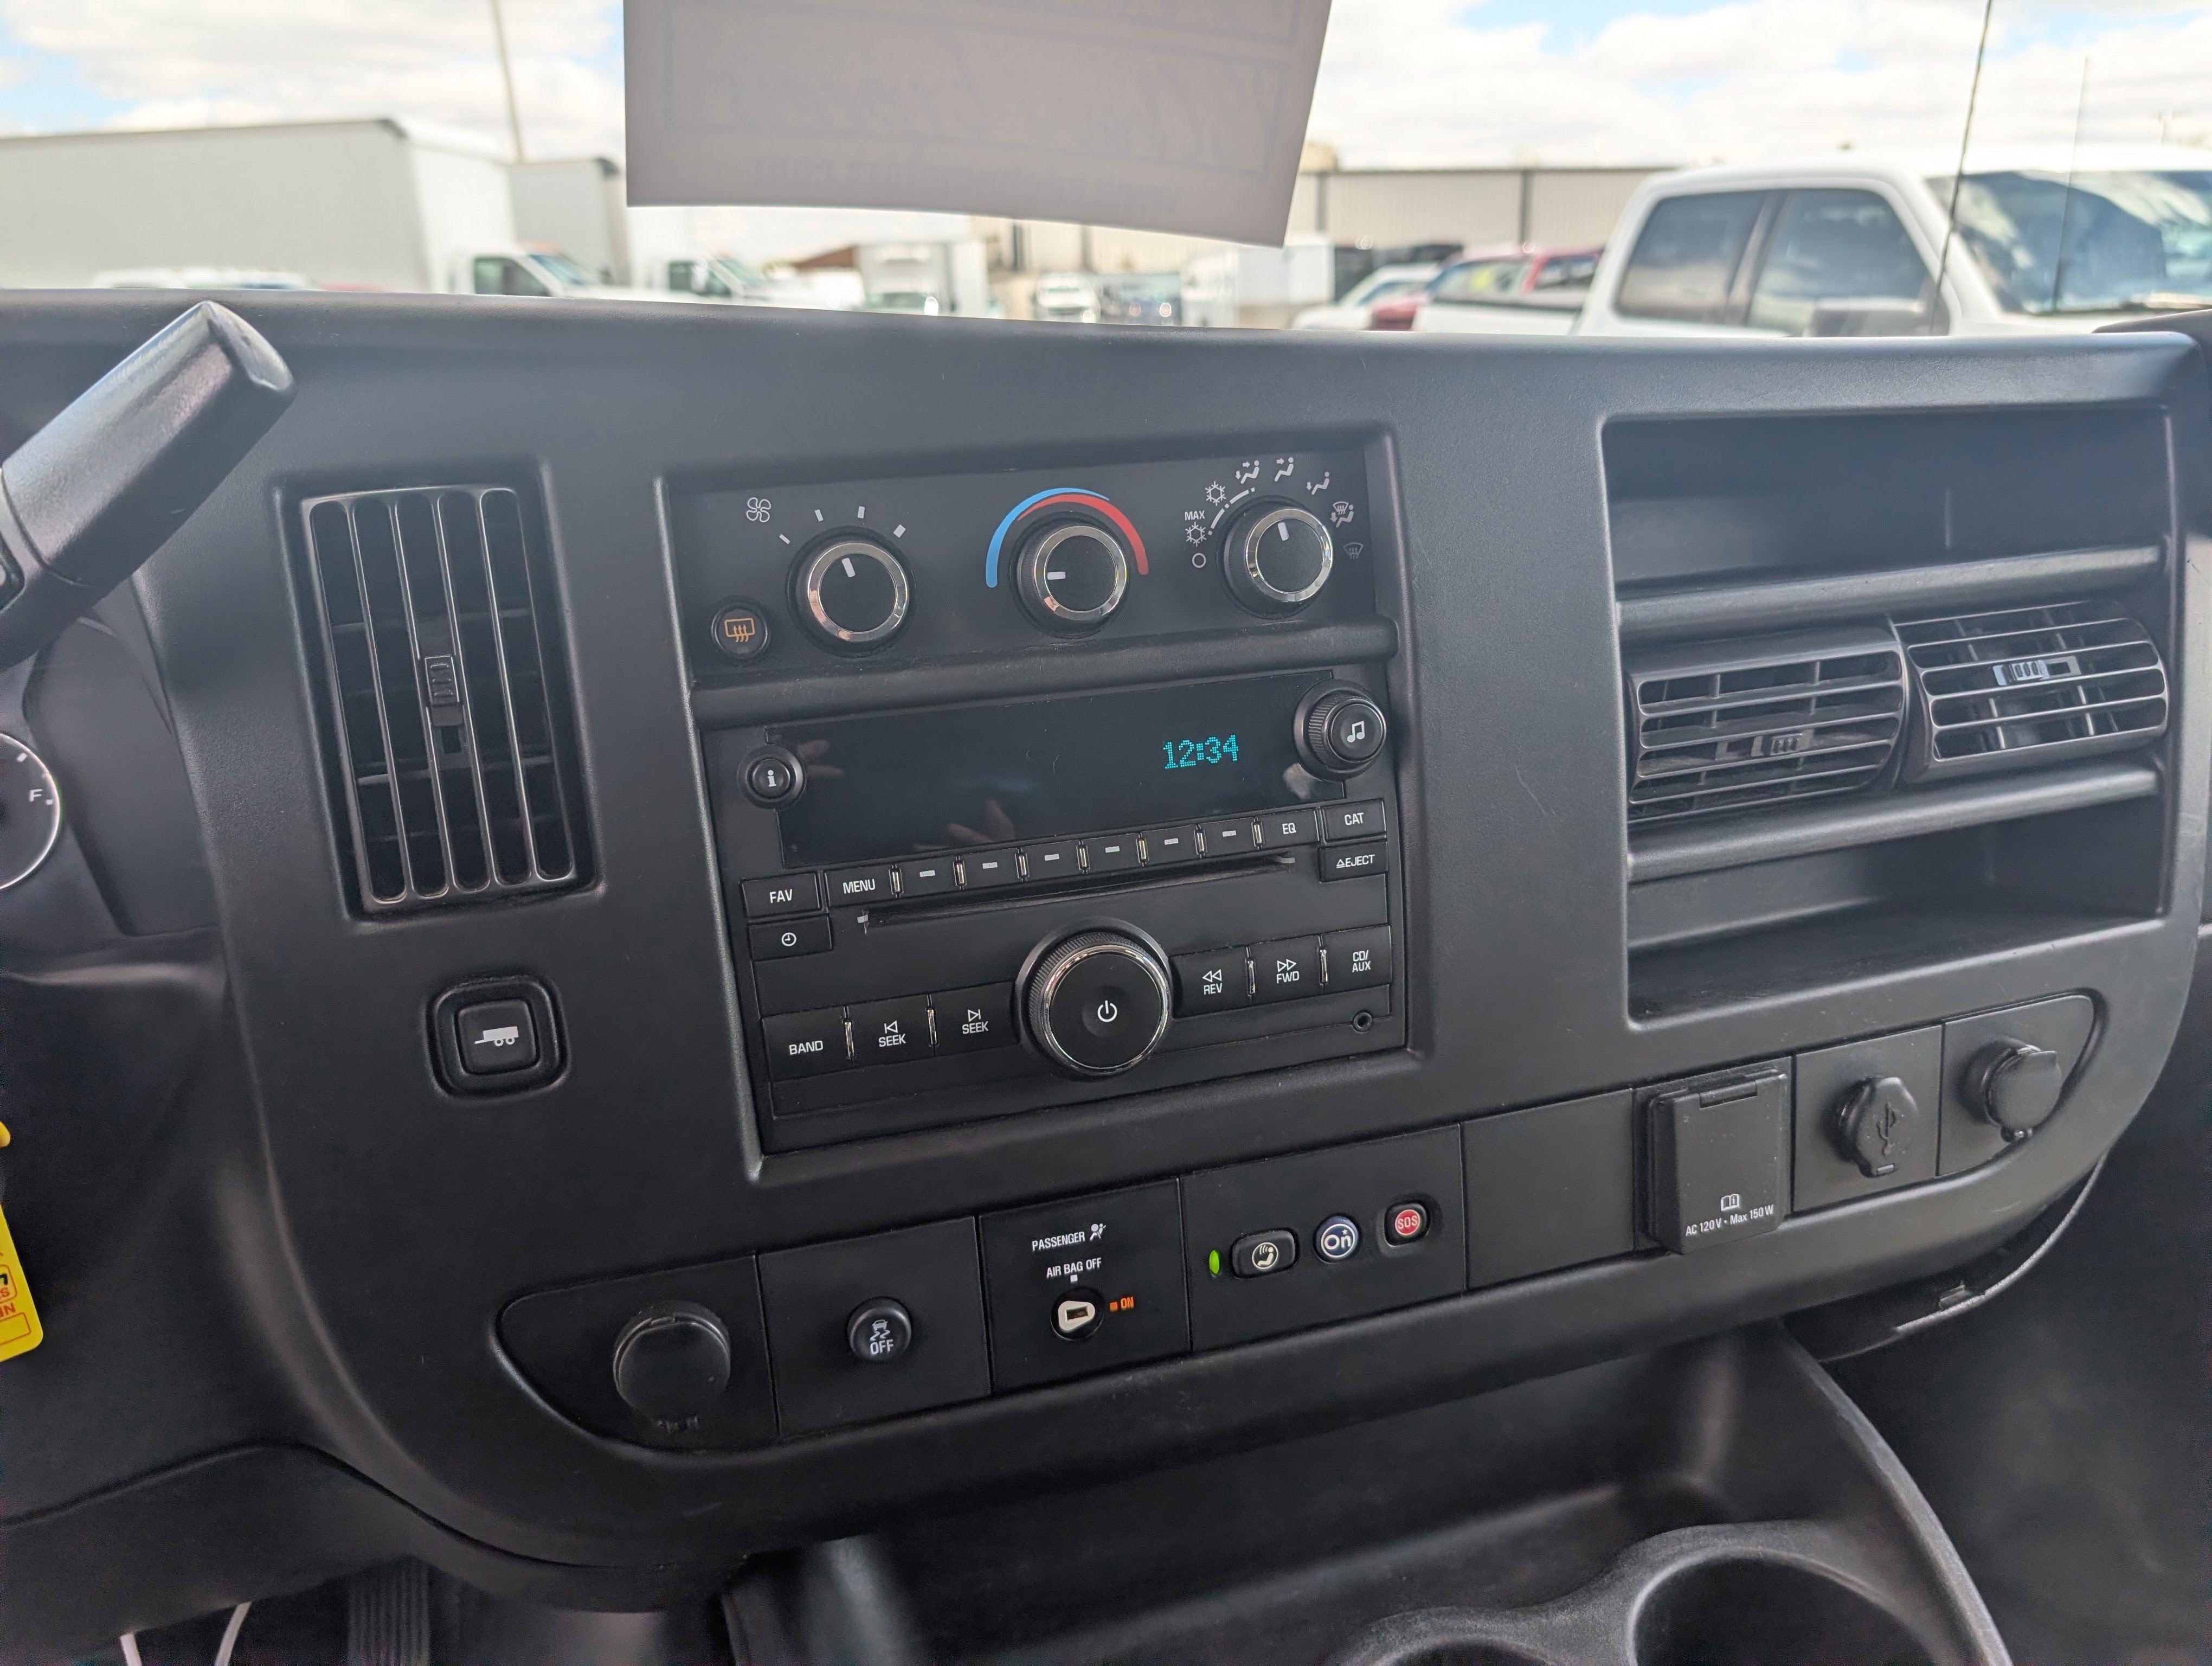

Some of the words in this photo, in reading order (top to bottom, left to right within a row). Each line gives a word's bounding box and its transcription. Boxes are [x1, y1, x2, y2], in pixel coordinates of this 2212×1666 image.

[1184, 510, 1205, 521] MAX
[1163, 734, 1239, 769] 12:34
[29, 789, 42, 802] F
[1344, 812, 1364, 825] CAT
[1282, 822, 1297, 835] EQ
[1345, 854, 1375, 868] EJECT
[843, 878, 876, 894] MENU
[769, 888, 793, 904] FAV
[1353, 949, 1371, 962] CD/
[1352, 961, 1371, 973] AUX
[1276, 970, 1300, 984] FWD
[1204, 984, 1223, 995] REV
[962, 1021, 989, 1034] SEEK
[789, 1040, 824, 1055] BAND
[878, 1034, 906, 1047] SEEK
[1397, 1215, 1419, 1231] SOS
[1685, 1224, 1697, 1236] AC
[1730, 1213, 1748, 1225] Max
[1032, 1231, 1085, 1251] PASSENGER
[1323, 1234, 1353, 1251] On
[1046, 1265, 1062, 1278] AIR
[1063, 1261, 1083, 1276] BAG
[1085, 1257, 1102, 1270] OFF
[1120, 1296, 1134, 1310] ON
[870, 1340, 894, 1356] OFF
